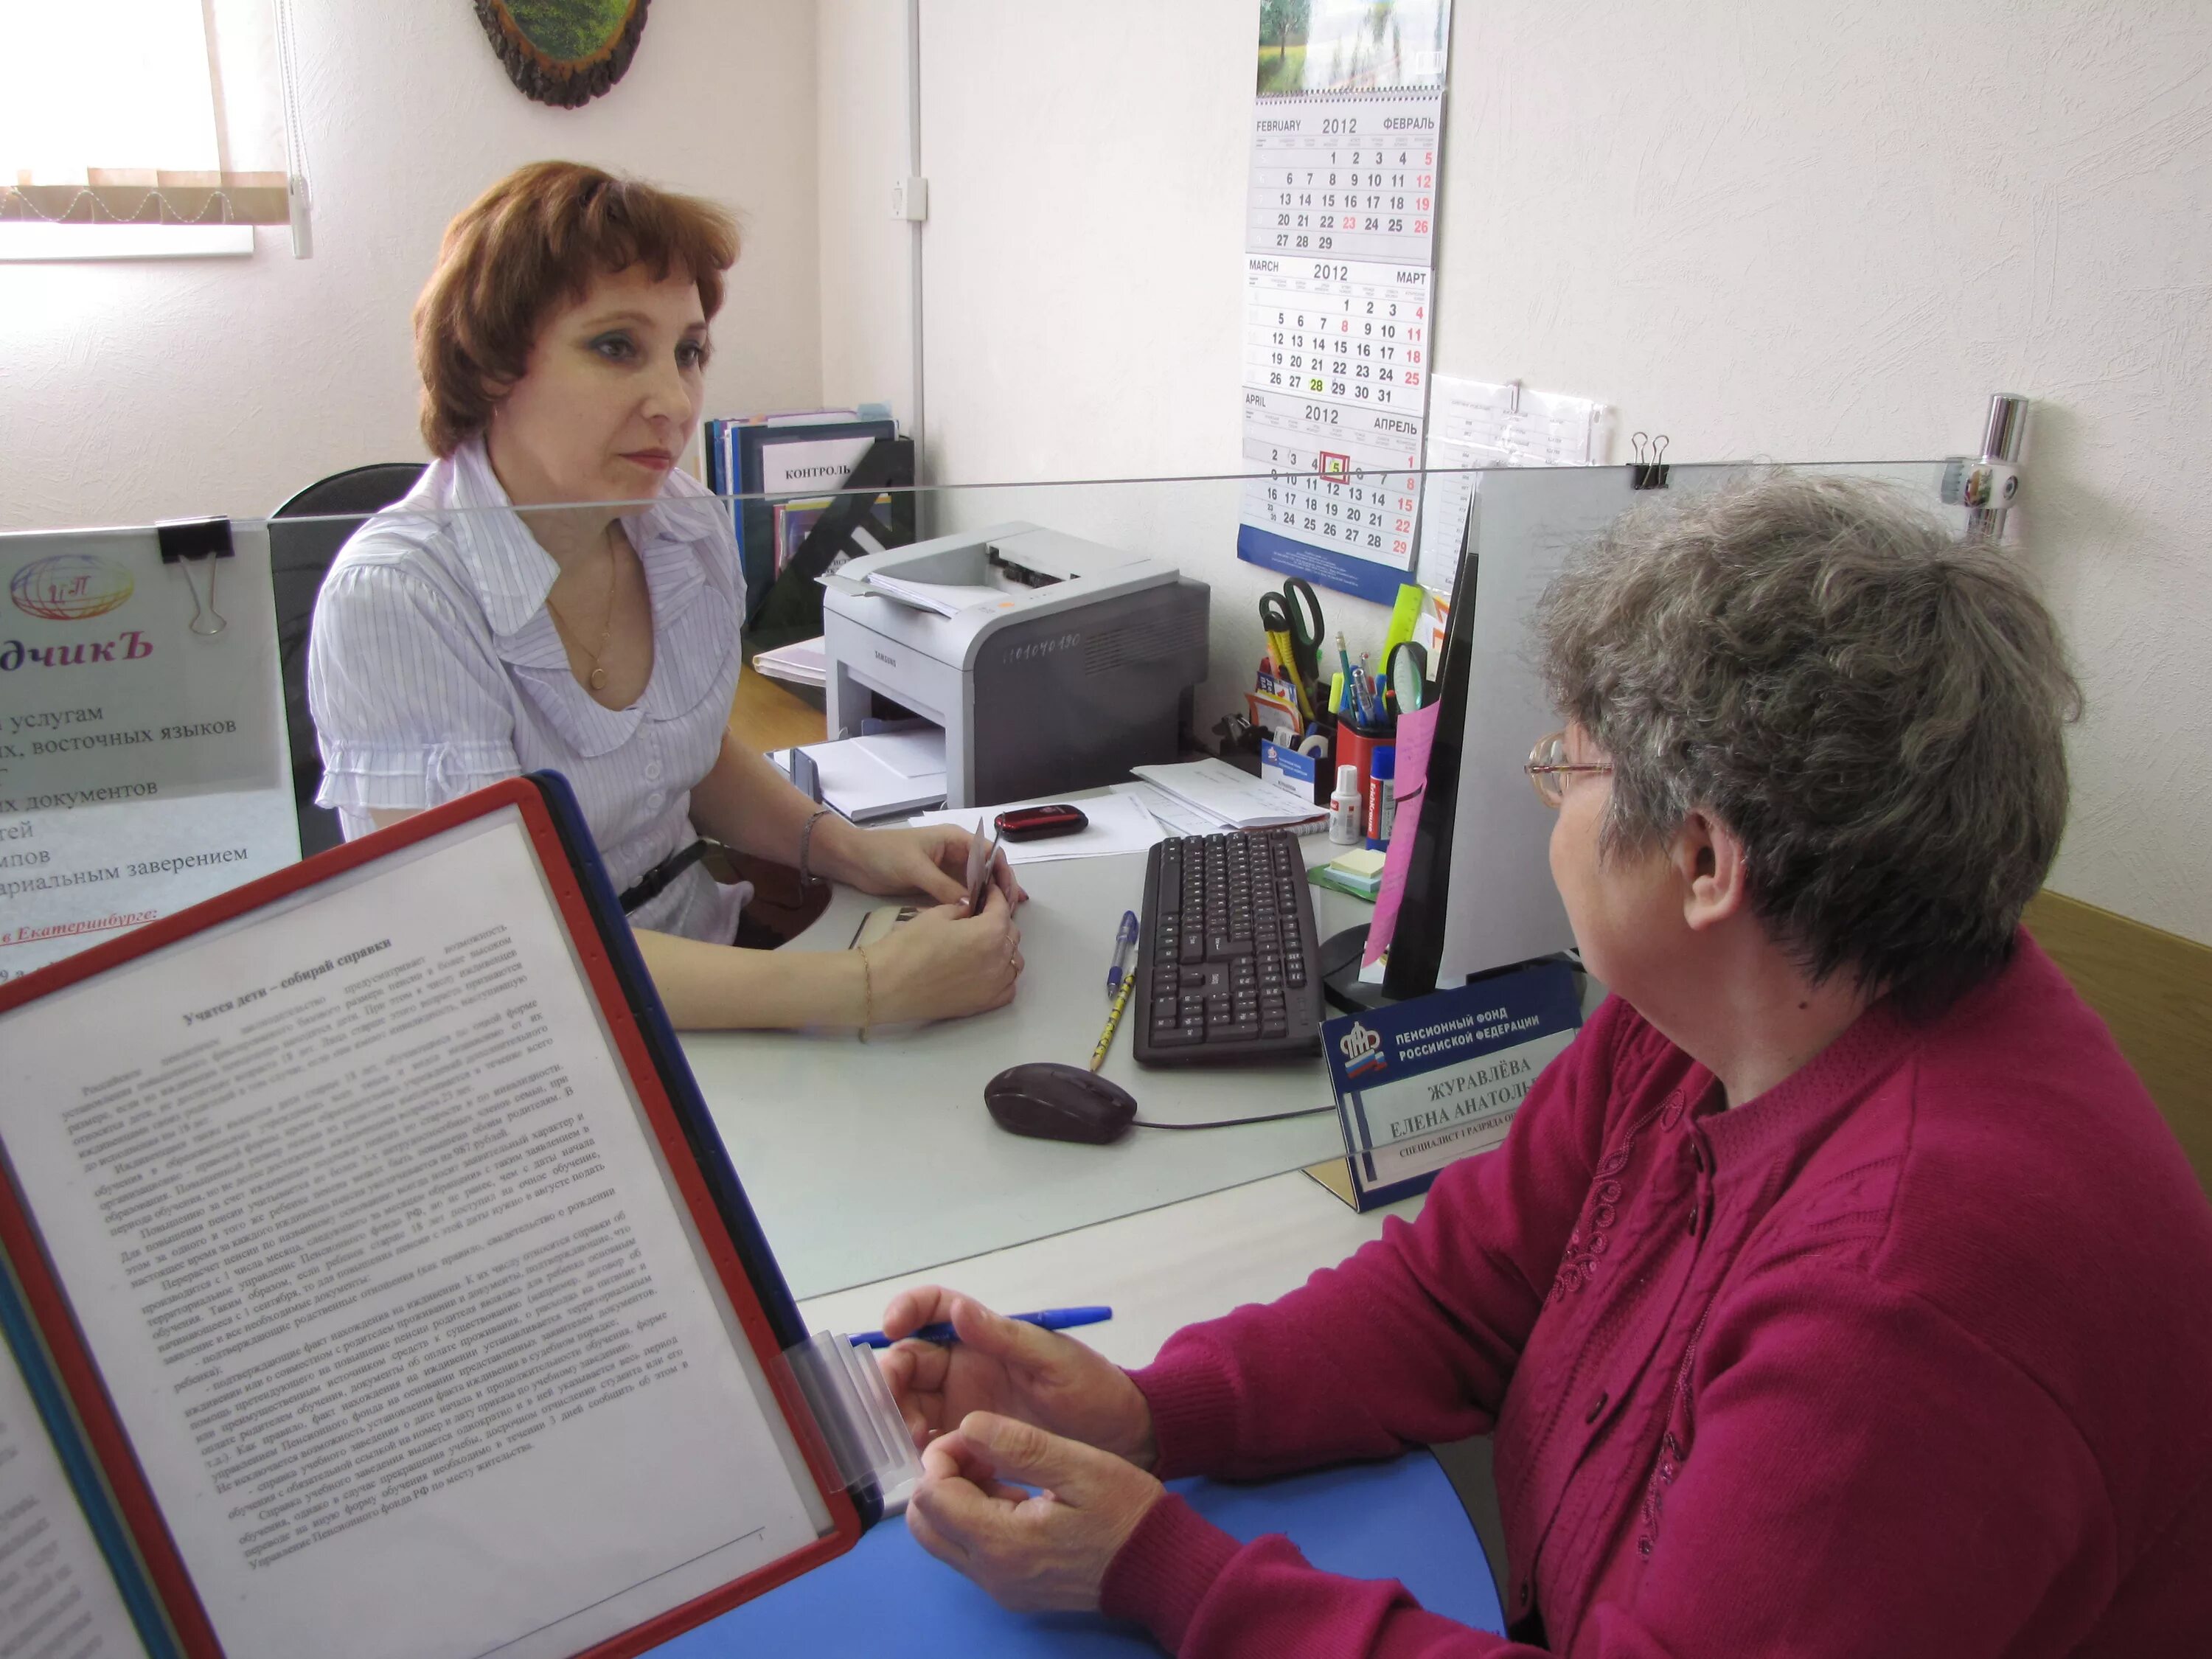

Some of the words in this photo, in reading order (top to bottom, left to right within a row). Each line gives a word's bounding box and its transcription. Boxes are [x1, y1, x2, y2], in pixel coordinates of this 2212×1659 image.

[1257, 120, 1301, 131] FEBRUARY
[1323, 119, 1357, 133] 2012
[1384, 118, 1434, 130] ФЕВРАЛЬ
[1332, 152, 1335, 164] 1
[1353, 152, 1359, 164] 2
[1376, 152, 1382, 164] 3
[1399, 152, 1406, 164] 4
[1425, 153, 1432, 165] 5
[1287, 173, 1293, 184] 6
[1307, 173, 1313, 184] 7
[1329, 173, 1335, 186] 8
[1352, 174, 1357, 186] 9
[1368, 174, 1381, 187] 10
[1392, 175, 1403, 187] 11
[1417, 175, 1430, 188] 12
[1280, 193, 1291, 205] 13
[1300, 194, 1311, 206] 14
[1323, 195, 1335, 206] 15
[1345, 195, 1357, 207] 16
[1367, 196, 1380, 209] 17
[1391, 197, 1404, 209] 18
[1416, 198, 1429, 211] 19
[1278, 214, 1290, 226] 20
[1298, 215, 1308, 226] 21
[1320, 216, 1334, 228] 22
[1343, 217, 1355, 229] 23
[1365, 218, 1378, 230] 24
[1388, 219, 1402, 232] 25
[1414, 220, 1427, 234] 26
[1277, 234, 1288, 246] 27
[1296, 236, 1308, 248] 28
[1319, 237, 1332, 249] 29
[1250, 260, 1279, 271] MARCH
[1314, 264, 1347, 281] 2012
[1397, 271, 1426, 285] МАРТ
[1345, 299, 1349, 311] 1
[1367, 302, 1374, 313] 2
[1389, 304, 1396, 316] 3
[1416, 307, 1423, 319] 4
[1279, 313, 1284, 324] 5
[1298, 316, 1304, 327] 6
[1321, 318, 1326, 330] 7
[1341, 320, 1348, 333] 8
[1365, 323, 1371, 335] 9
[1382, 325, 1395, 338] 10
[1408, 328, 1420, 341] 11
[1273, 333, 1283, 344] 12
[1292, 335, 1303, 347] 13
[1313, 338, 1325, 350] 14
[1335, 341, 1347, 353] 15
[1357, 344, 1370, 356] 16
[1380, 347, 1394, 359] 17
[1407, 350, 1420, 364] 18
[1272, 352, 1282, 364] 19
[1290, 355, 1301, 367] 20
[1312, 358, 1322, 371] 21
[1333, 361, 1346, 375] 22
[1356, 365, 1369, 378] 23
[1380, 368, 1393, 381] 24
[1405, 372, 1419, 385] 25
[1270, 372, 1281, 384] 26
[1290, 375, 1301, 388] 27
[1311, 379, 1322, 392] 28
[1332, 382, 1345, 395] 29
[1355, 386, 1368, 399] 30
[1378, 389, 1391, 403] 31
[1246, 394, 1265, 407] APRIL
[1306, 406, 1338, 424] 2012
[1374, 418, 1416, 434] АПРЕЛЬ
[785, 464, 851, 480] КОНТРОЛЬ
[1273, 449, 1277, 461] 2
[1291, 453, 1296, 465] 3
[1312, 459, 1318, 470] 4
[1333, 462, 1339, 473] 5
[1380, 473, 1387, 484] 7
[1407, 478, 1414, 490] 8
[1408, 456, 1413, 468] 1
[1307, 478, 1317, 490] 11
[1326, 482, 1340, 495] 12
[1349, 487, 1362, 501] 13
[1372, 493, 1385, 506] 14
[1398, 498, 1412, 512] 15
[1268, 487, 1277, 500] 16
[1285, 493, 1295, 504] 17
[1306, 498, 1317, 510] 18
[1326, 503, 1338, 515] 19
[1347, 508, 1360, 521] 20
[1369, 513, 1382, 526] 21
[1395, 519, 1410, 533] 22
[1284, 512, 1295, 525] 24
[1304, 518, 1315, 531] 25
[1324, 523, 1336, 536] 26
[1346, 529, 1359, 541] 27
[1368, 534, 1381, 547] 28
[1393, 540, 1406, 554] 29
[10, 708, 102, 734] услугам
[32, 730, 153, 754] восточных
[161, 721, 236, 740] языков
[26, 781, 159, 811] документов
[127, 849, 247, 876] заверением
[3, 933, 12, 943] в
[18, 908, 158, 942] Екатеринбурге:
[444, 925, 507, 955] возможность
[459, 949, 518, 978] иждивенцев
[182, 1001, 234, 1026] Учатся
[237, 988, 268, 1008] дети
[280, 959, 335, 989] собирай
[336, 939, 392, 967] справки
[1395, 1014, 1474, 1045] ПЕНСИОННЫЙ
[1476, 1007, 1509, 1023] ФОНД
[1475, 1015, 1540, 1040] ФЕДЕРАЦИИ
[1428, 1058, 1531, 1100] ЖУРАВЛЁВА
[1391, 1111, 1451, 1140] ЕЛЕНА
[1399, 1131, 1460, 1158] СПЕЦИАЛИСТ
[1467, 1119, 1503, 1136] РАЗРЯДА
[571, 1164, 605, 1182] подать
[161, 1262, 220, 1291] Перерасчет
[223, 1246, 260, 1266] пенсии
[532, 1117, 574, 1139] характер
[202, 1322, 291, 1365] подтверждающие
[293, 1295, 358, 1329] родственные
[567, 1188, 616, 1215] рождении
[380, 1450, 445, 1484] прекращения
[248, 1538, 311, 1571] Управление
[311, 1509, 380, 1543] Пенсионного
[380, 1495, 413, 1514] фонда
[412, 1486, 429, 1499] РФ
[431, 1481, 445, 1492] по
[445, 1468, 474, 1485] месту
[476, 1442, 536, 1472] жительства.
